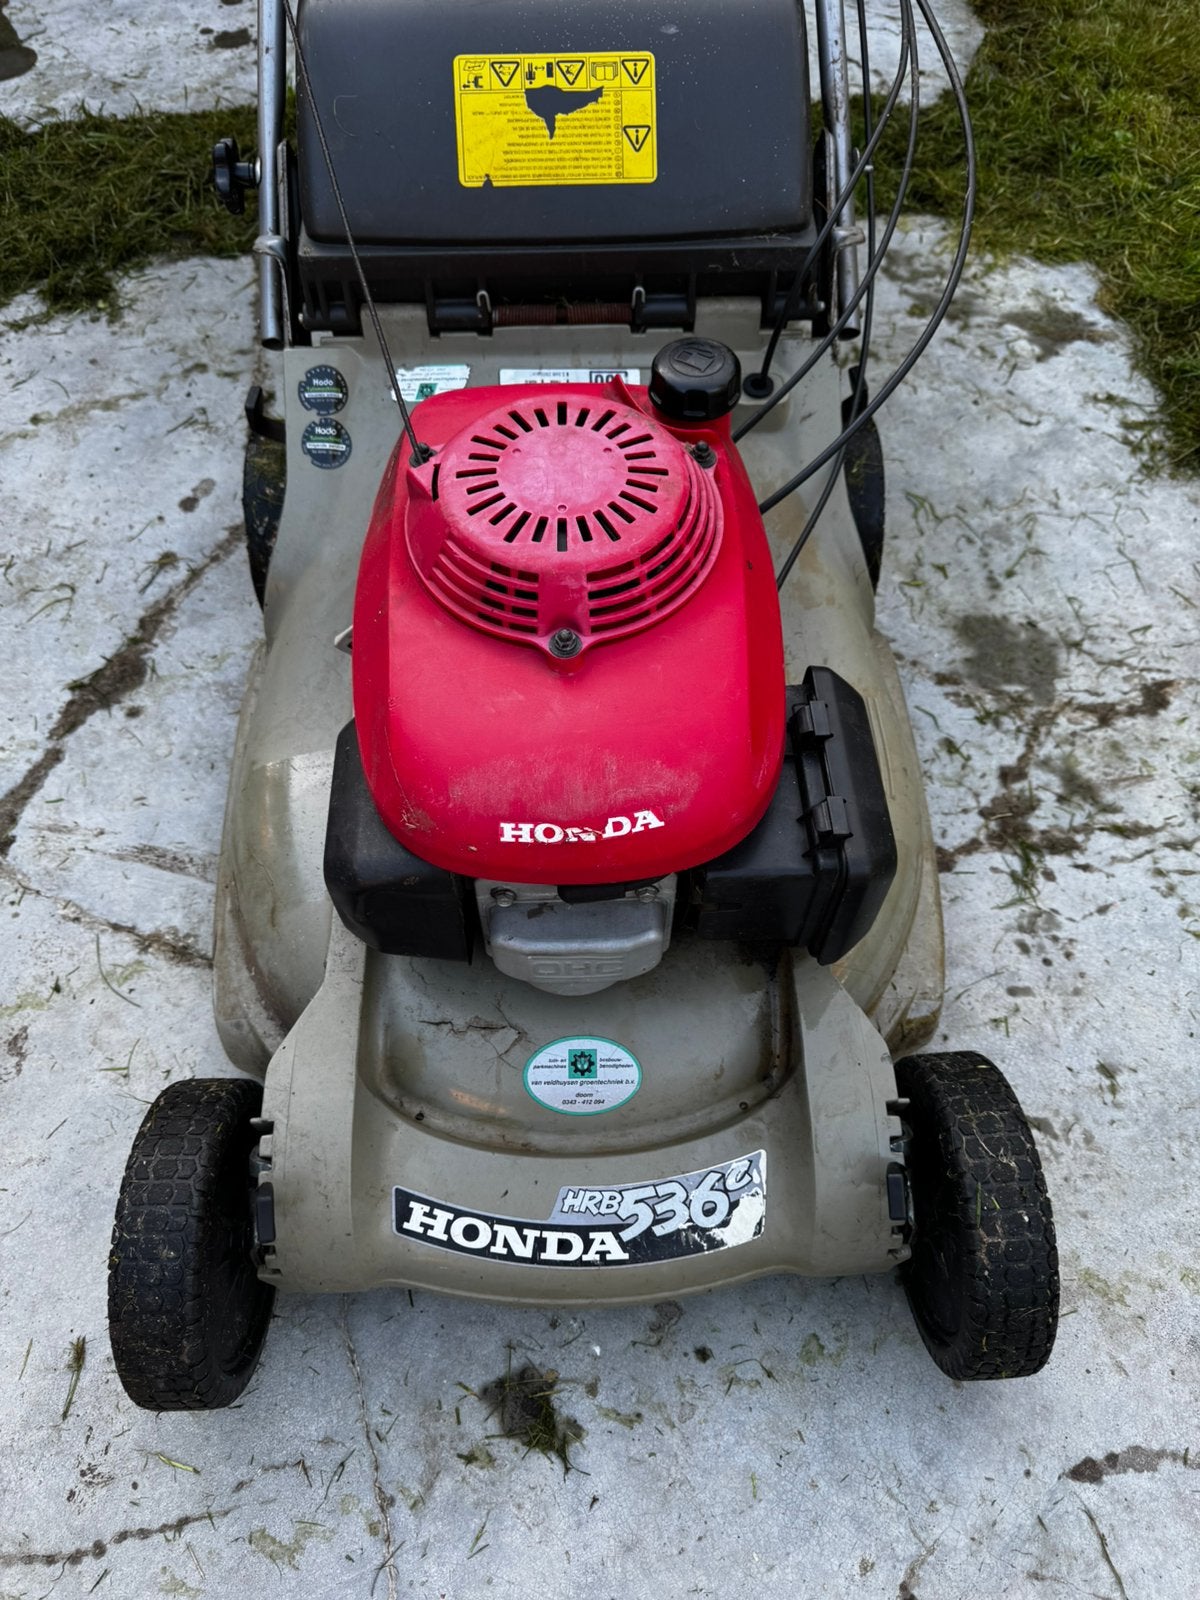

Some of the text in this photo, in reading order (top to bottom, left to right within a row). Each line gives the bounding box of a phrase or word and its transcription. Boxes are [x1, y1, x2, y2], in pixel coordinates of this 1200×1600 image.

[543, 1079, 578, 1087] veldhuysen
[579, 1079, 625, 1087] groentechniek
[402, 1200, 630, 1262] HONDA
